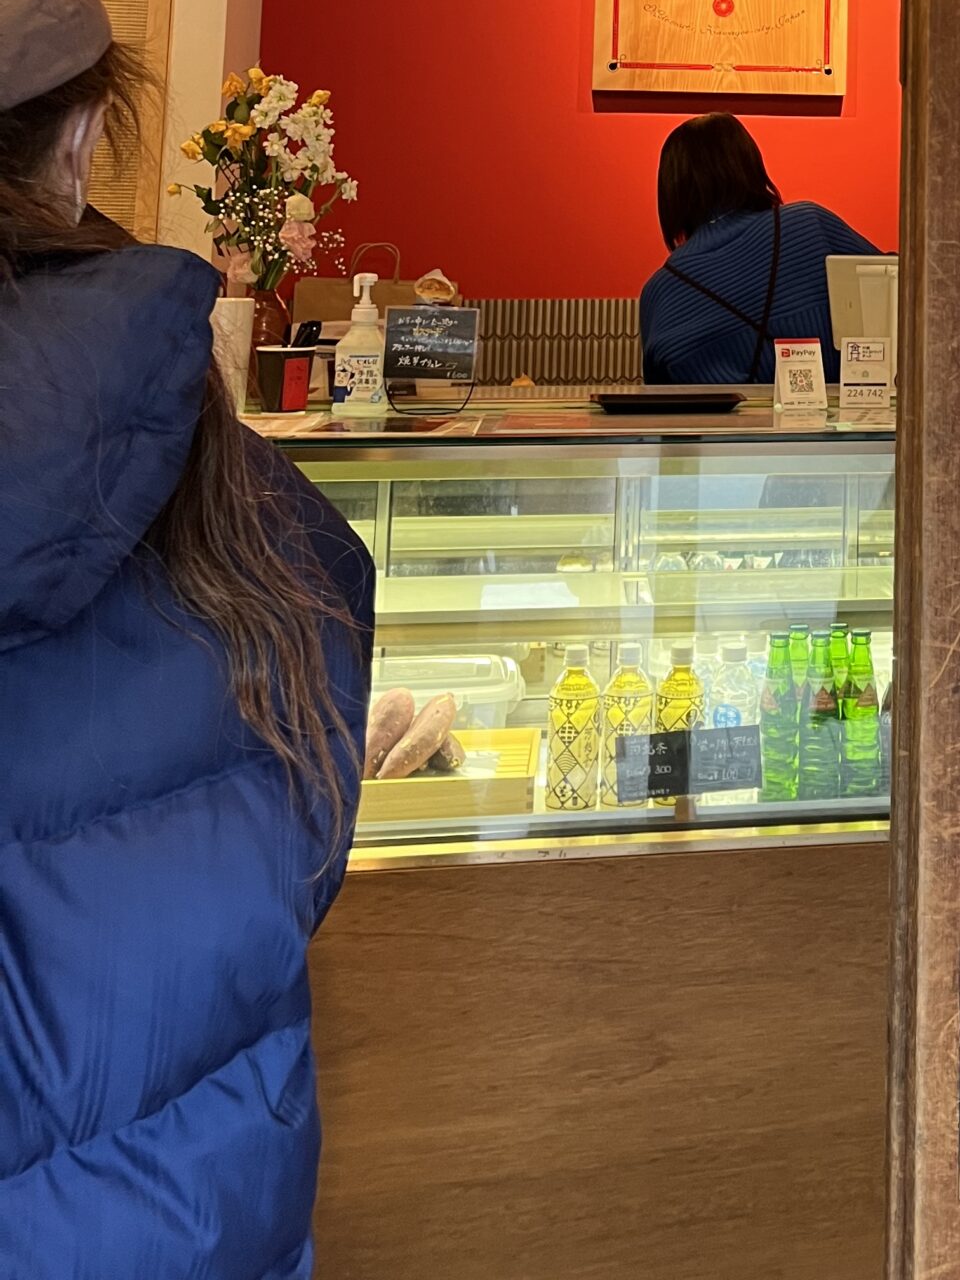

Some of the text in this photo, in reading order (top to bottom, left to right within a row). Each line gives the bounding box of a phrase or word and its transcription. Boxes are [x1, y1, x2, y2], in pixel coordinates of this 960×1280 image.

[791, 348, 816, 357] PayPay
[847, 389, 884, 398] 224 742
